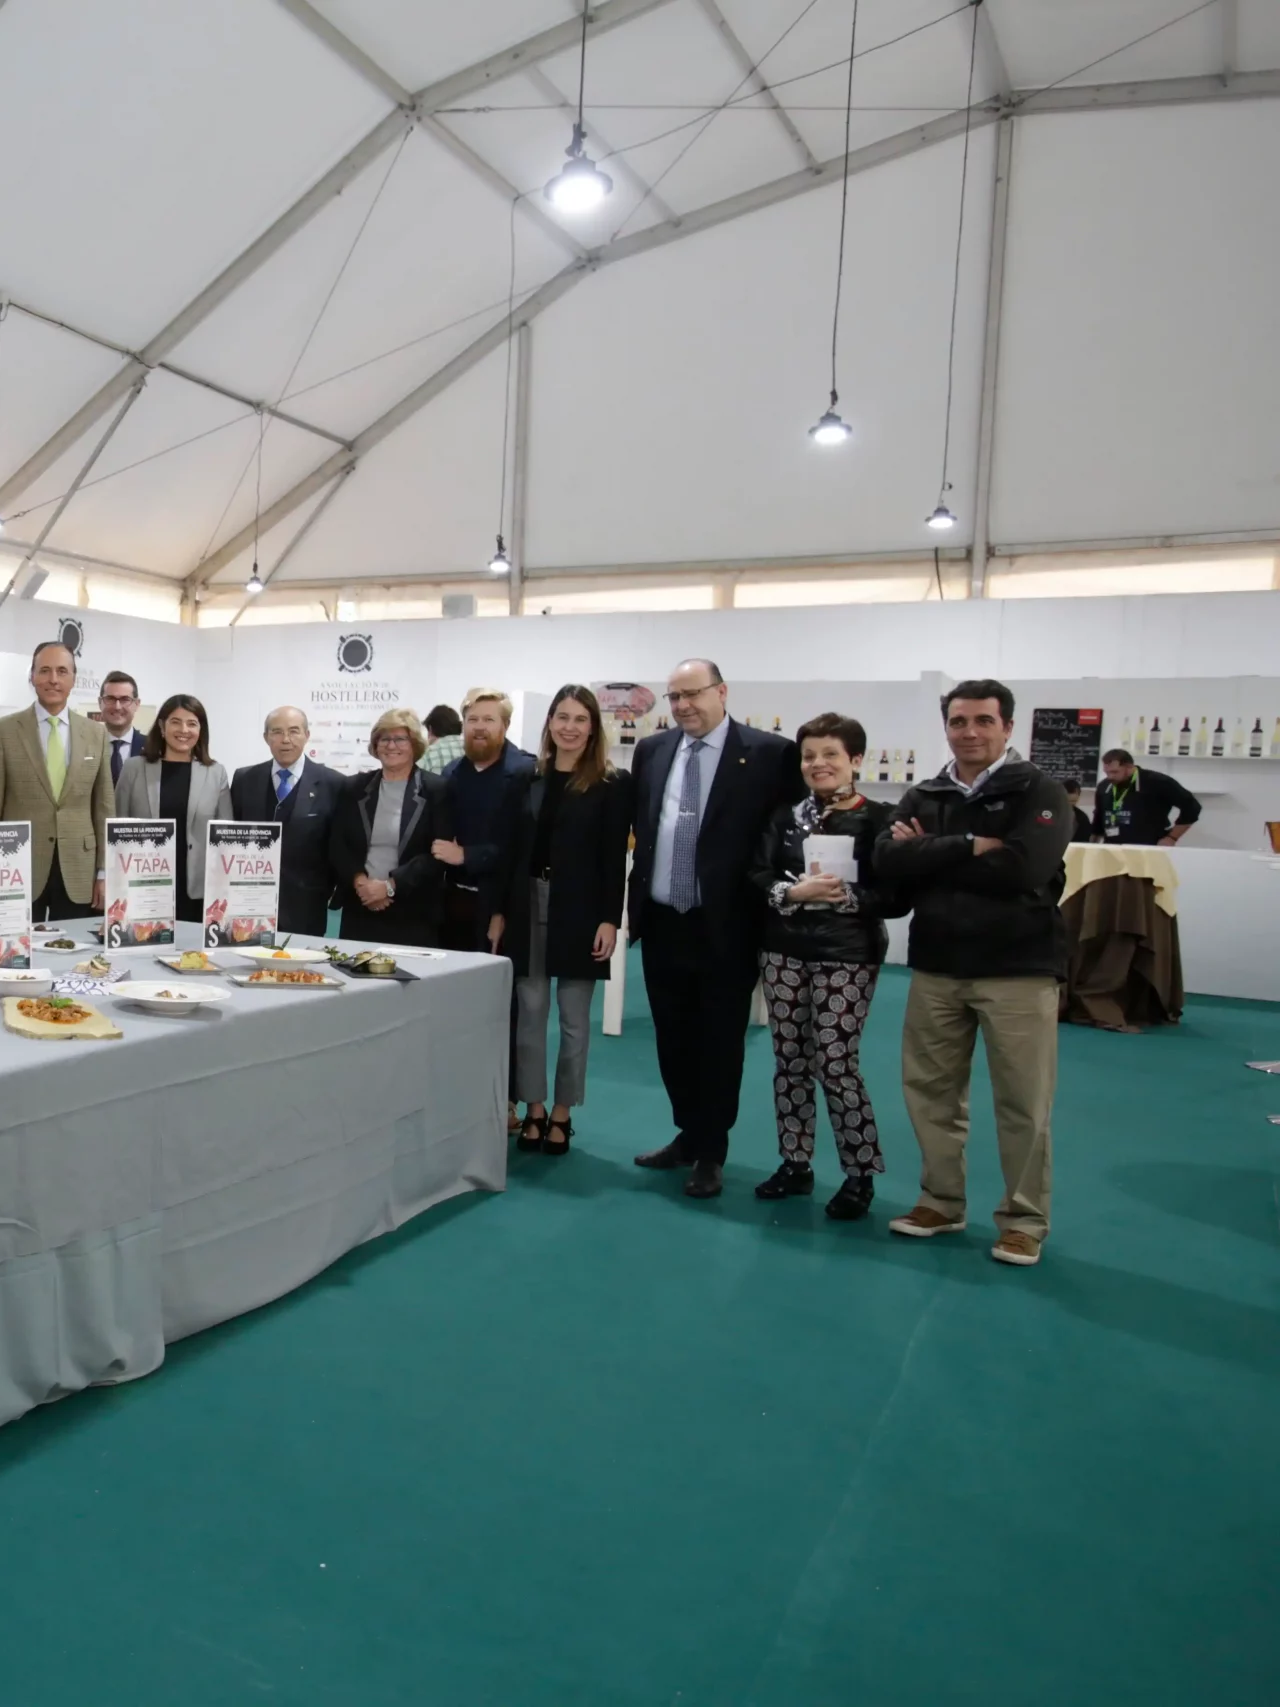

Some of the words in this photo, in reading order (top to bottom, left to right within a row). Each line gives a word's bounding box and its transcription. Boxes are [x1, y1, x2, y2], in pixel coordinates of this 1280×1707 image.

[311, 691, 400, 702] HOSTELEROS
[119, 853, 132, 874] V
[134, 858, 170, 873] TAPA
[221, 855, 235, 874] V
[236, 861, 274, 874] TAPA
[111, 925, 121, 947] S
[208, 925, 218, 947] S
